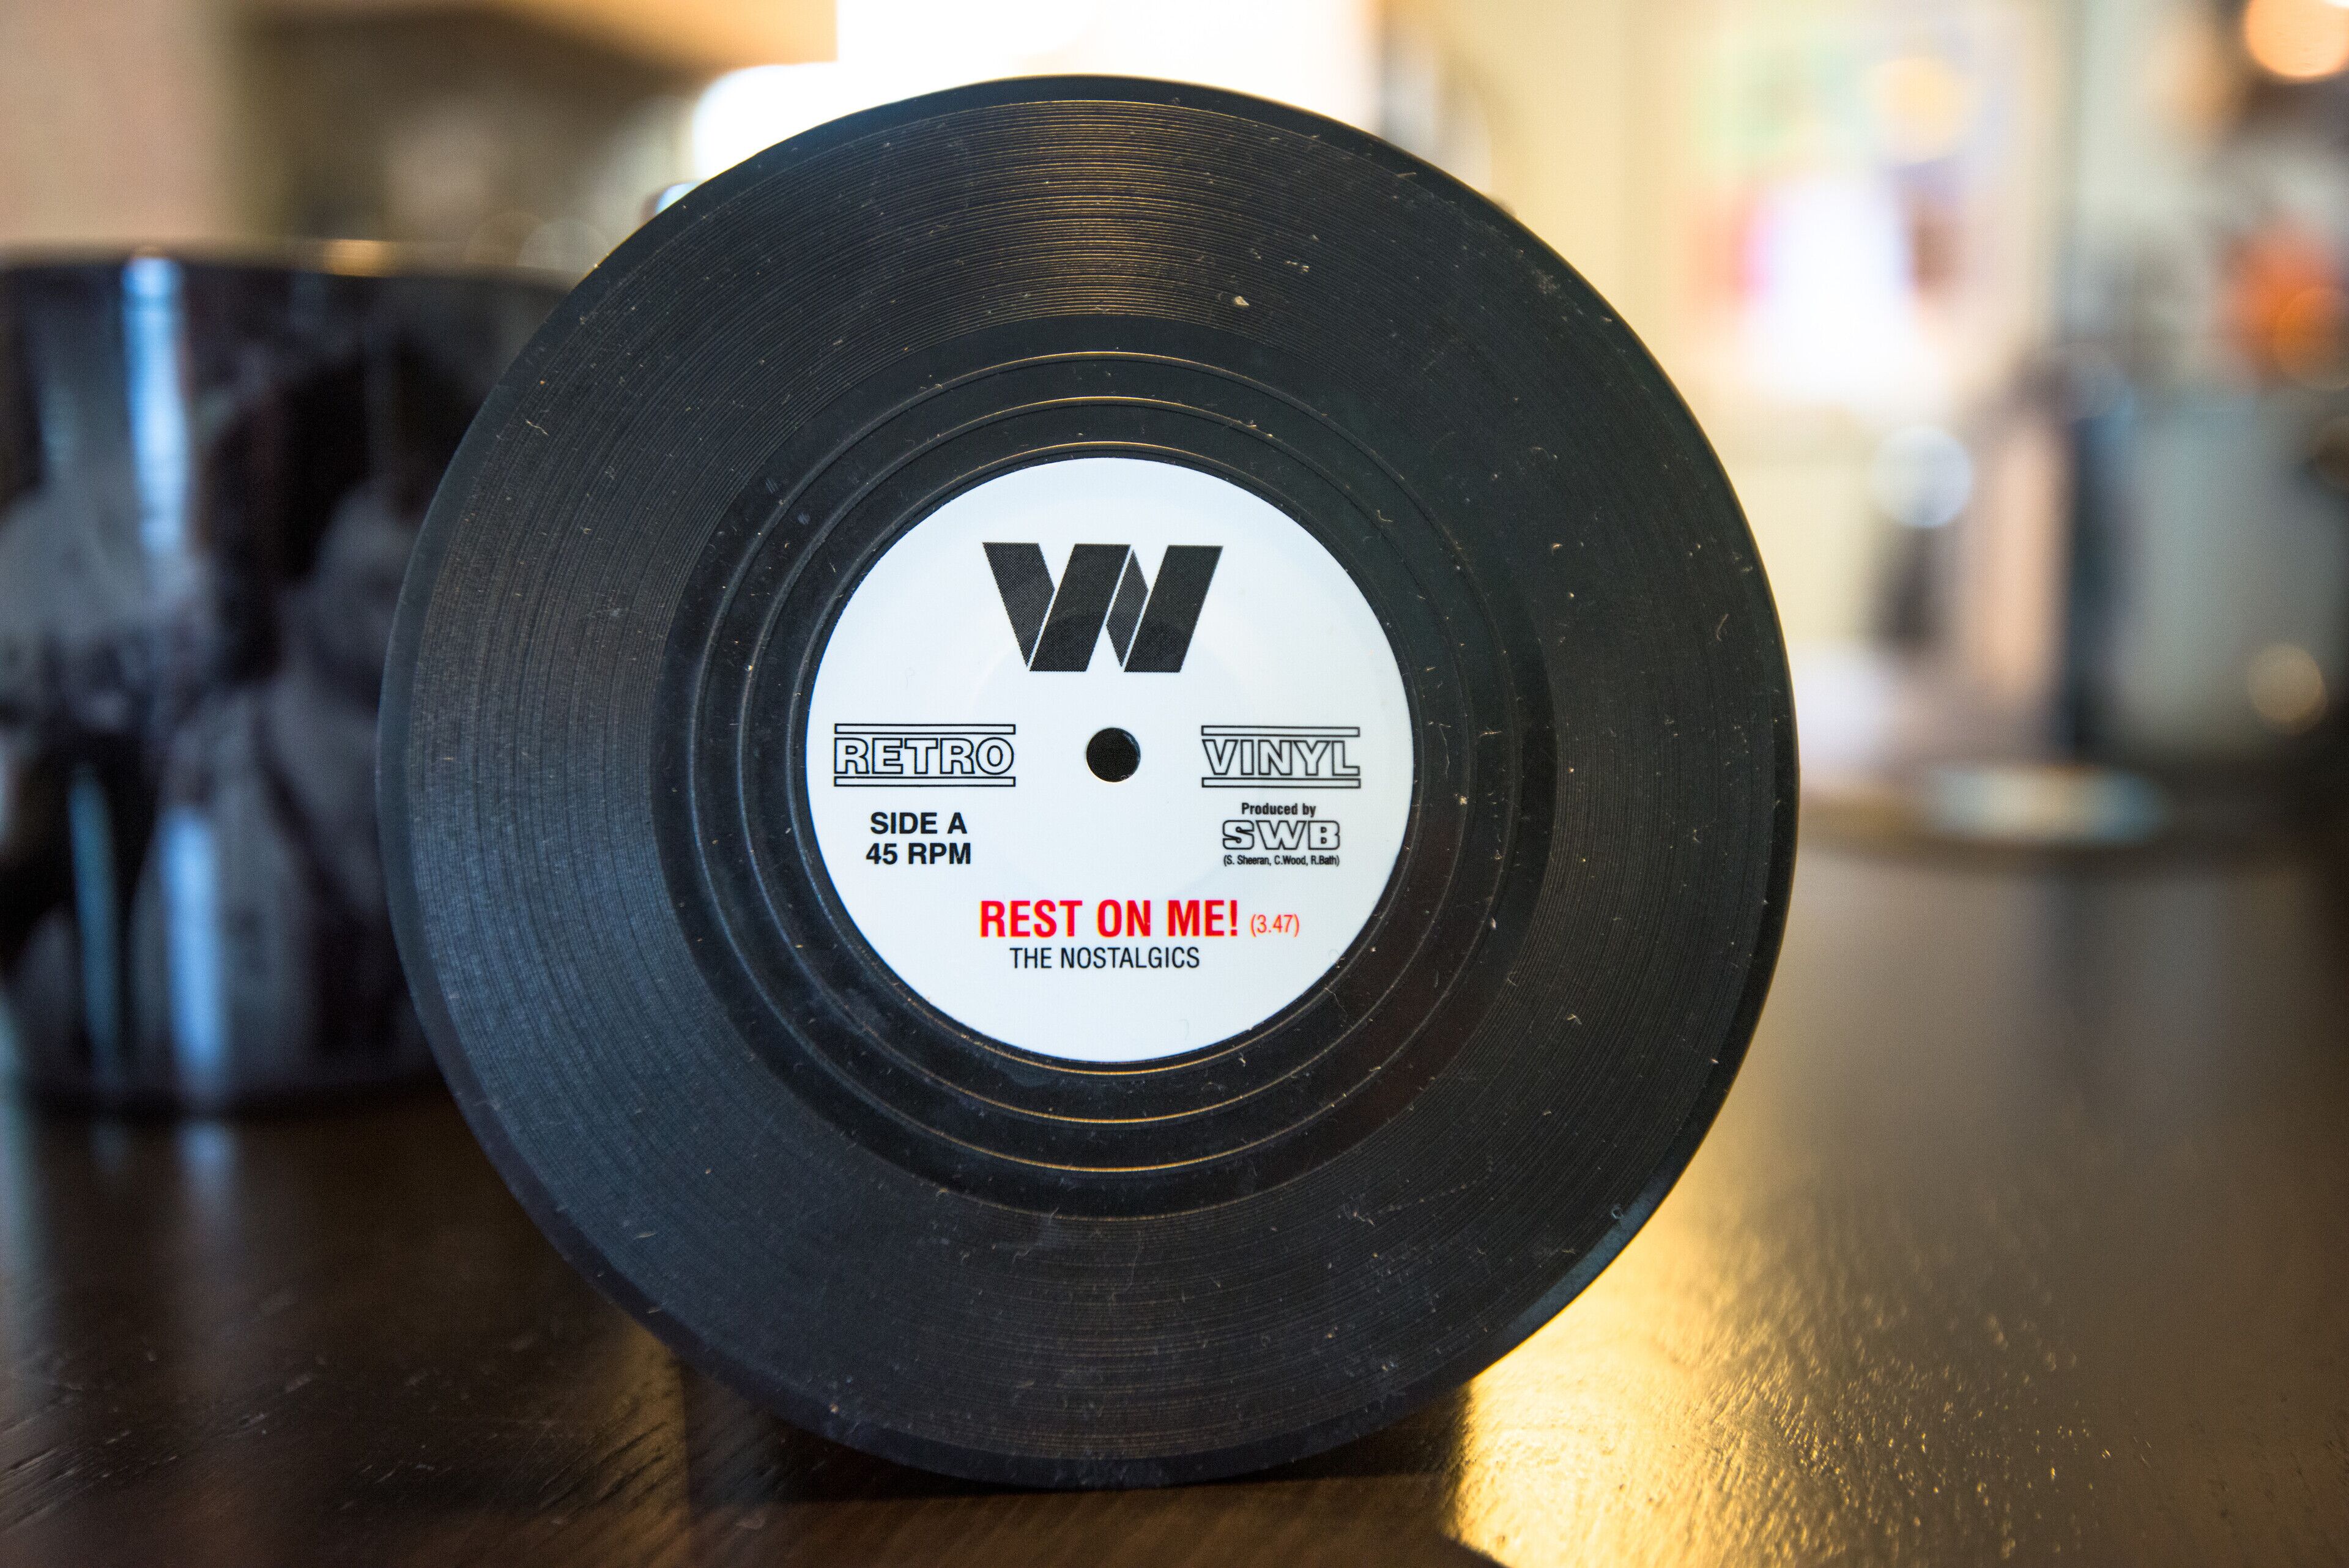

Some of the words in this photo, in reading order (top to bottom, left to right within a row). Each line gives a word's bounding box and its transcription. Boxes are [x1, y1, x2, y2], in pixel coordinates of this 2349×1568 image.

[834, 737, 1014, 775] RETRO
[1201, 739, 1360, 776] VINYL
[1241, 802, 1297, 815] Produced
[1302, 803, 1316, 817] by
[870, 812, 938, 834] SIDE
[947, 812, 968, 834] A
[1222, 820, 1340, 850] SWB
[866, 842, 898, 864] 45
[908, 842, 971, 864] RPM
[1237, 855, 1272, 866] Sheeran,
[980, 900, 1083, 937] REST
[1097, 900, 1151, 937] ON
[1168, 900, 1238, 937] ME!
[1250, 914, 1300, 937] (3.47)
[1010, 947, 1052, 969] THE
[1061, 946, 1200, 969] NOSTALGICS
